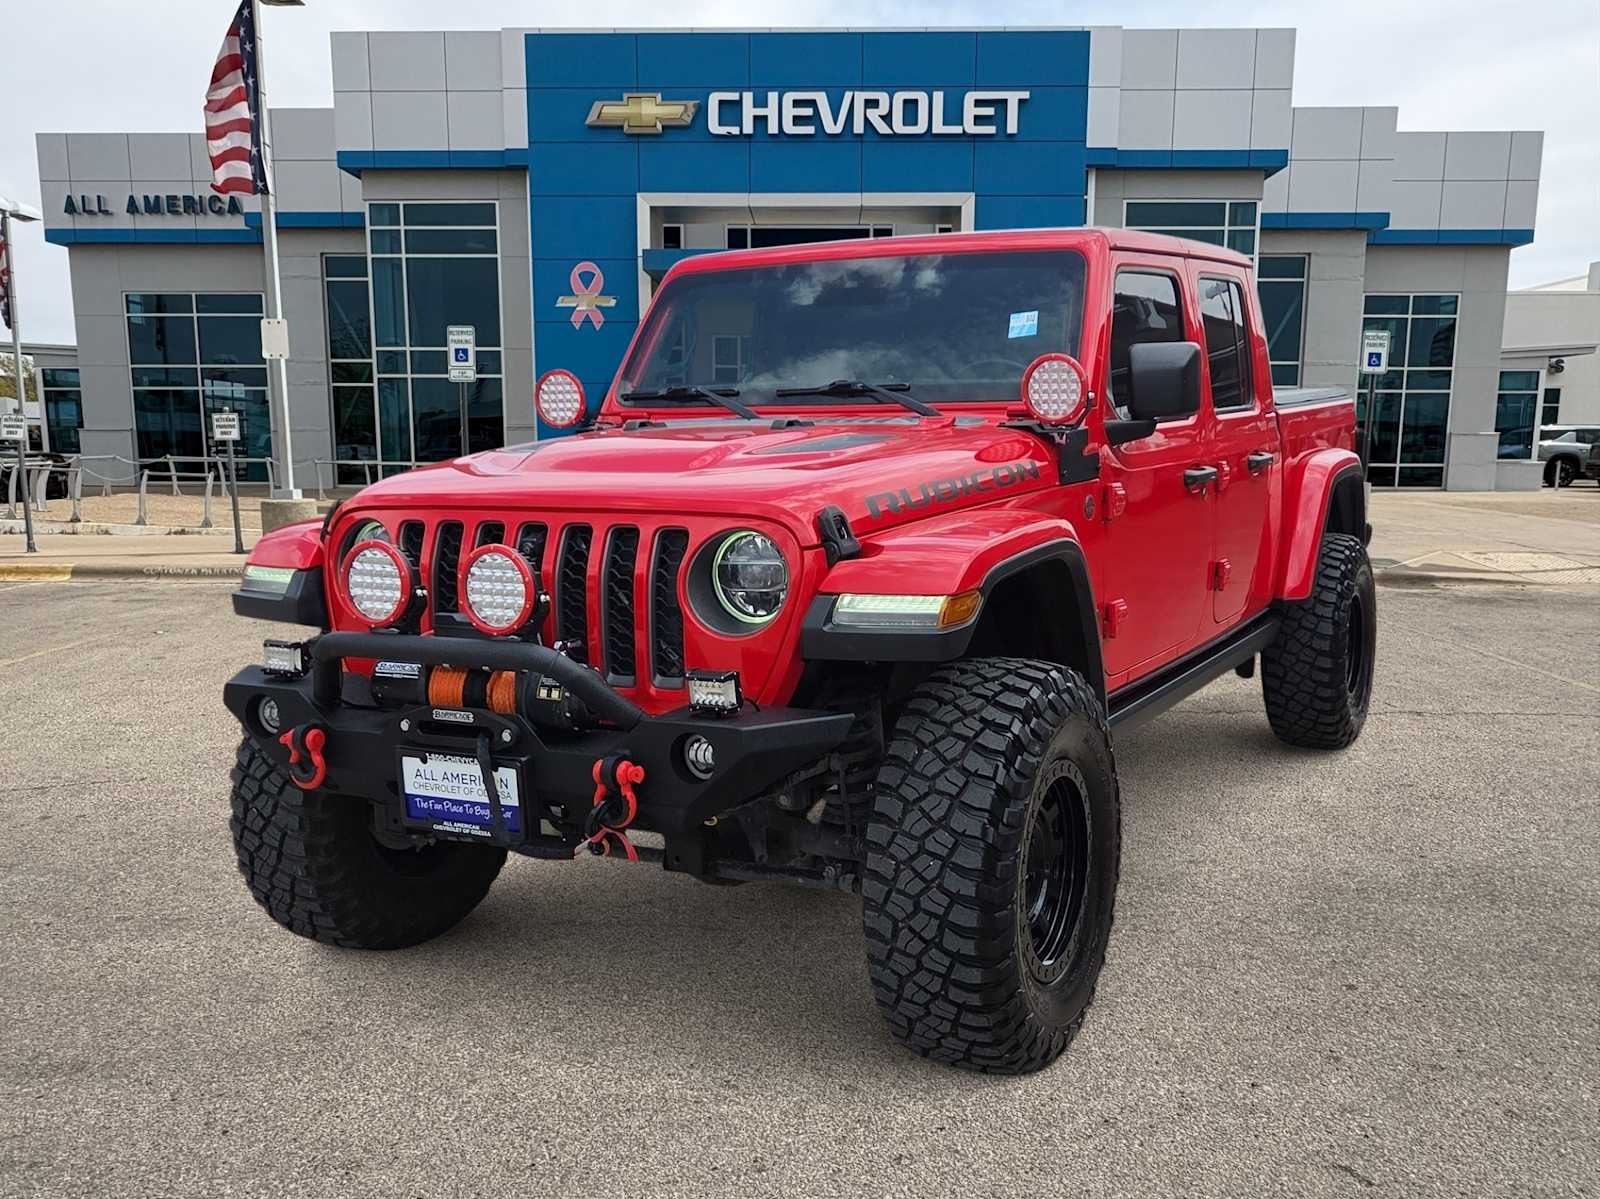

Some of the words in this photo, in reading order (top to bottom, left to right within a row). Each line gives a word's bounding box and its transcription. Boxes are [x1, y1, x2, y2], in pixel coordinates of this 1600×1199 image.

[707, 91, 1031, 135] CHEVROLET
[64, 194, 113, 216] ALL
[864, 461, 1040, 519] RUBICON
[433, 710, 473, 722] BARRICADE
[412, 780, 461, 795] CHEVROLET
[463, 786, 475, 797] OF
[414, 768, 439, 781] ALL
[441, 771, 508, 790] AMERIN
[413, 797, 429, 809] The
[429, 799, 443, 811] Fun
[443, 800, 464, 814] Place
[464, 803, 475, 815] To
[474, 805, 491, 820] Buy
[432, 824, 462, 834] CHEVROLET
[470, 829, 493, 838] ODESSA
[453, 821, 481, 831] AMERICAN
